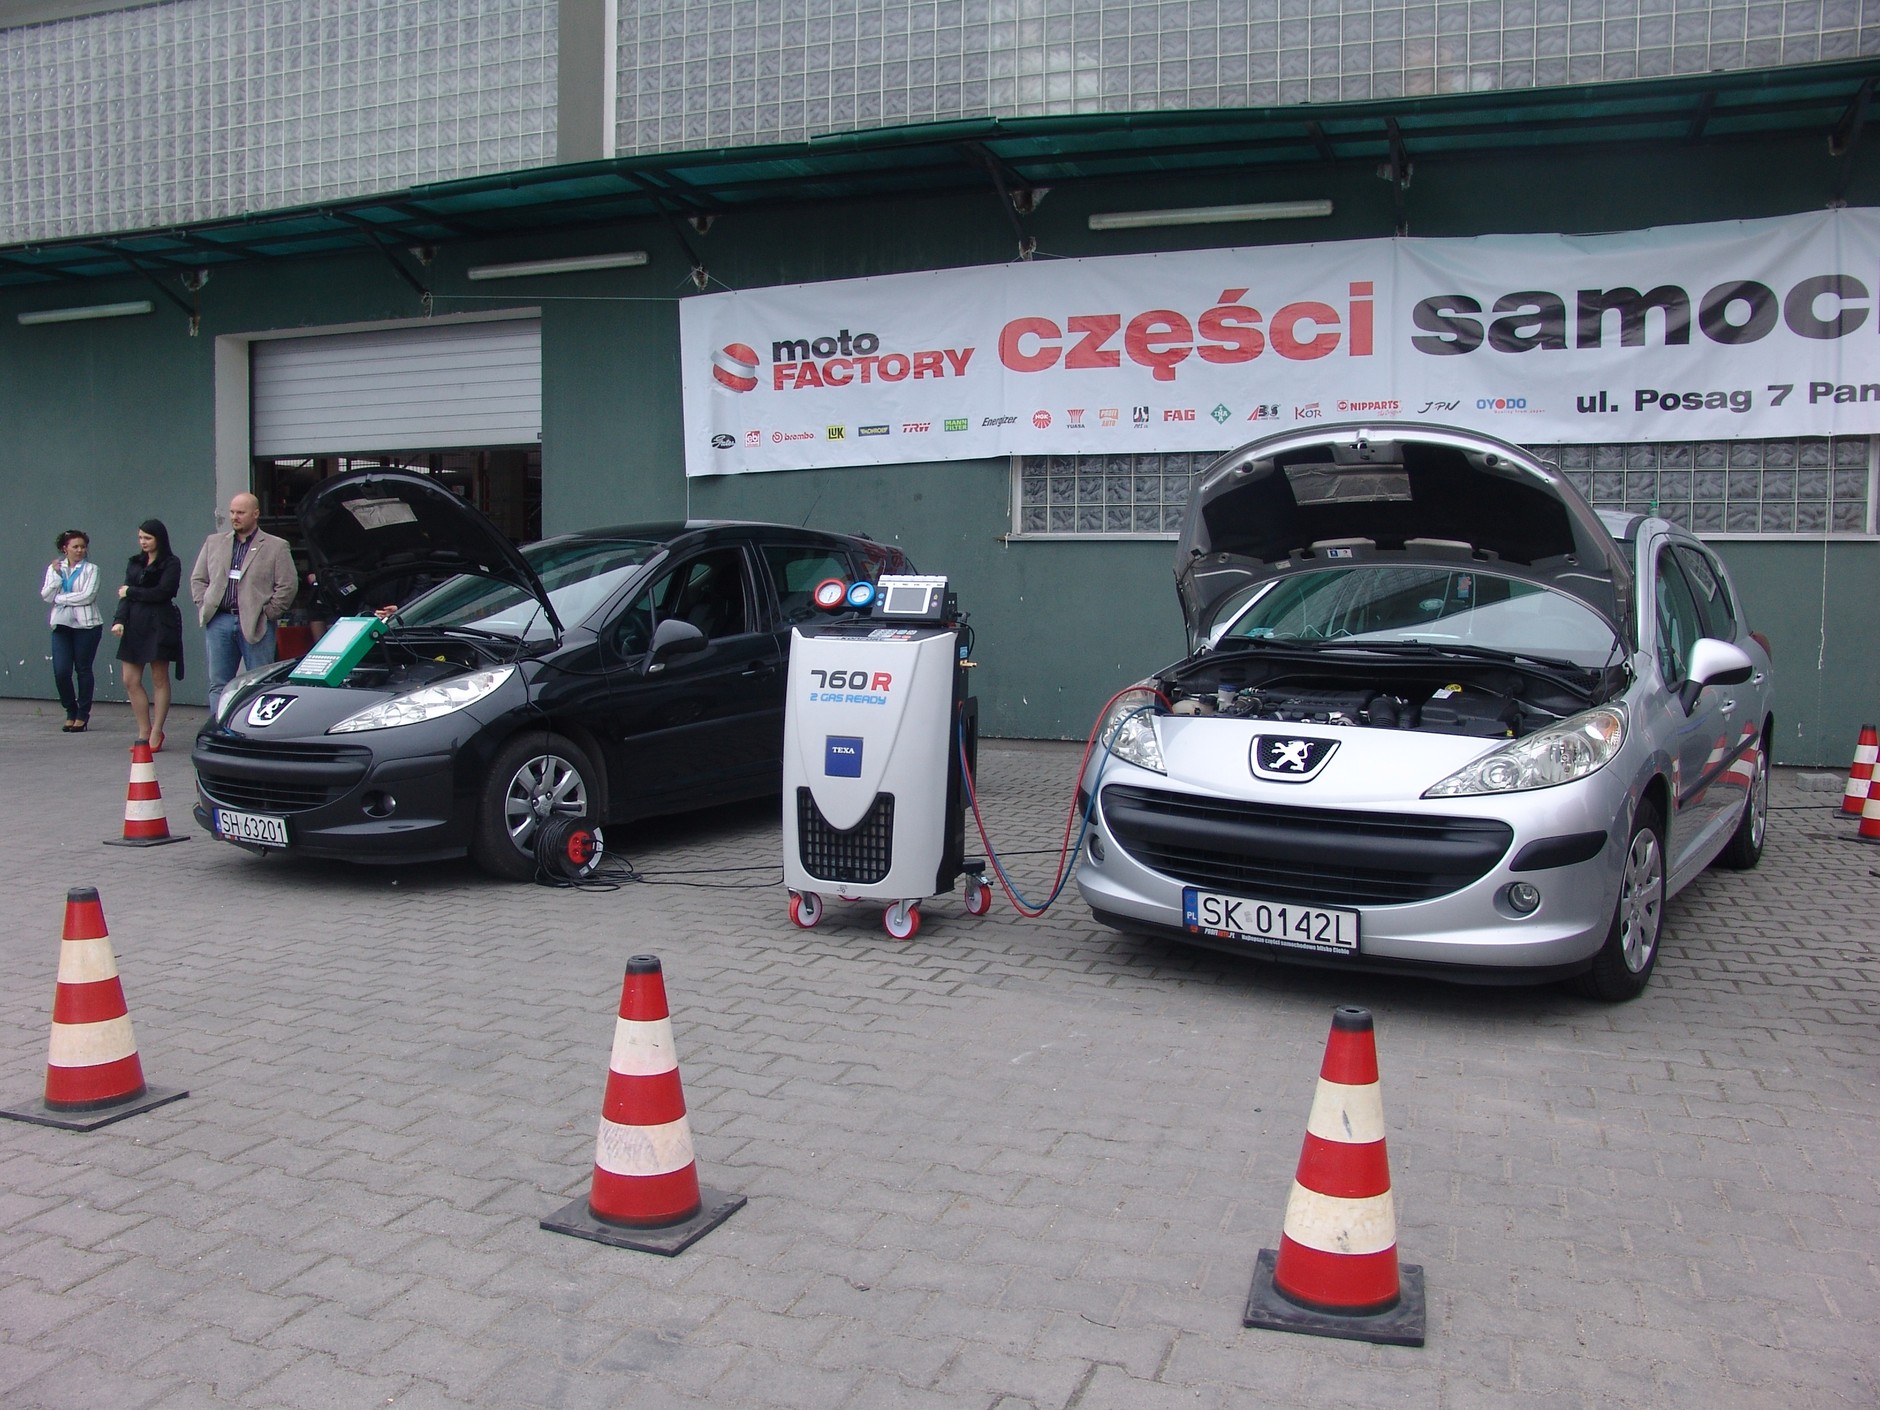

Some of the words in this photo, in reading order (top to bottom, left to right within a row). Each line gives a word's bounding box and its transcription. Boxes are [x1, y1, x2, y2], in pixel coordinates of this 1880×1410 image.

[998, 281, 1374, 382] części
[1411, 260, 1880, 356] samoc
[772, 329, 880, 362] moto
[773, 348, 975, 391] FACTORY
[1476, 398, 1527, 410] OYODO
[1576, 390, 1619, 413] ul.
[1634, 389, 1753, 413] Posag
[1767, 384, 1794, 407] 7
[1809, 382, 1880, 404] Pan
[1350, 400, 1399, 411] NIPPARTS
[981, 414, 1018, 427] Energizer
[1163, 409, 1195, 422] FAG
[902, 422, 931, 433] TRW
[810, 692, 818, 702] 2
[820, 693, 844, 703] GAS
[845, 694, 887, 705] READY
[832, 746, 855, 754] TEXA
[221, 812, 240, 835] SH
[244, 816, 284, 843] 63201
[1186, 911, 1197, 921] PL
[1203, 897, 1243, 931] SK
[1256, 904, 1352, 946] 0142L
